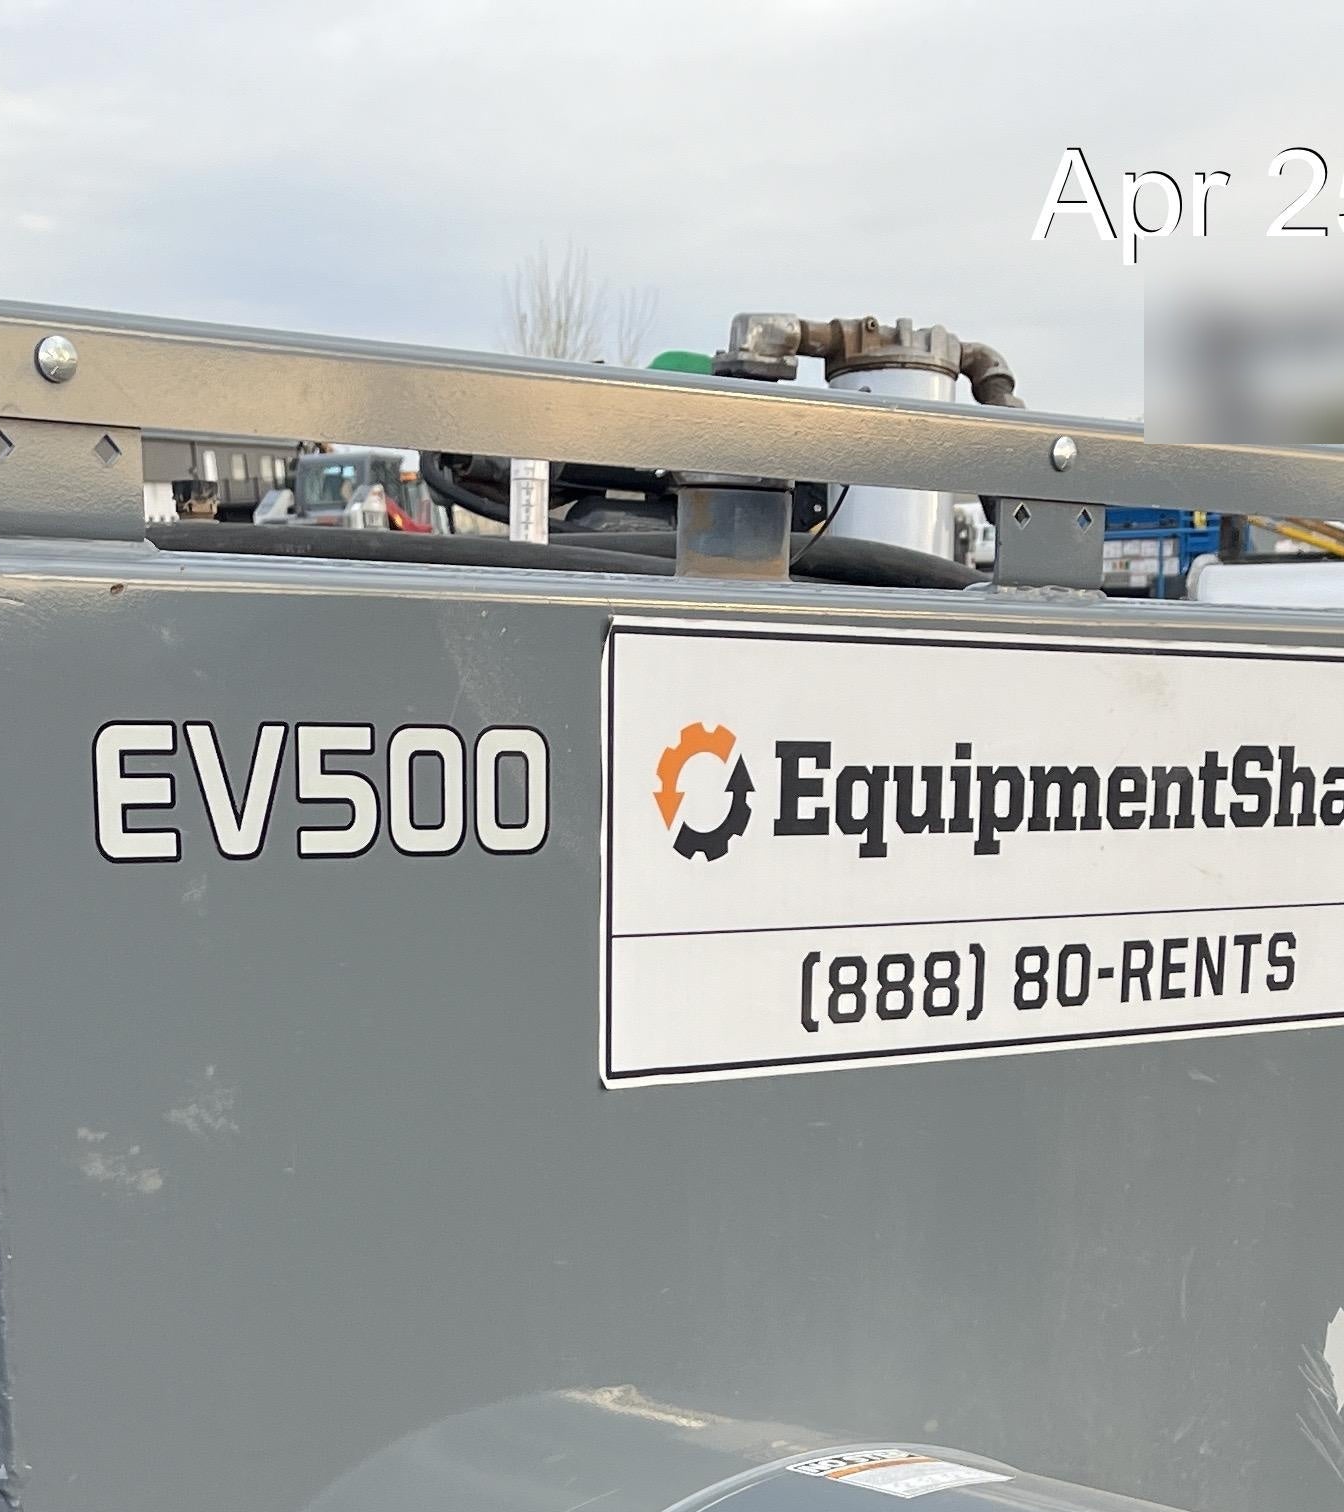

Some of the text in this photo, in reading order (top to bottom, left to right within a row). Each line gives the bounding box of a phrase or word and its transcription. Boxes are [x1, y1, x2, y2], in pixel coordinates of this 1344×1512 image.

[92, 719, 550, 863] EV500
[801, 931, 1298, 1033] (888) 80-RENTS
